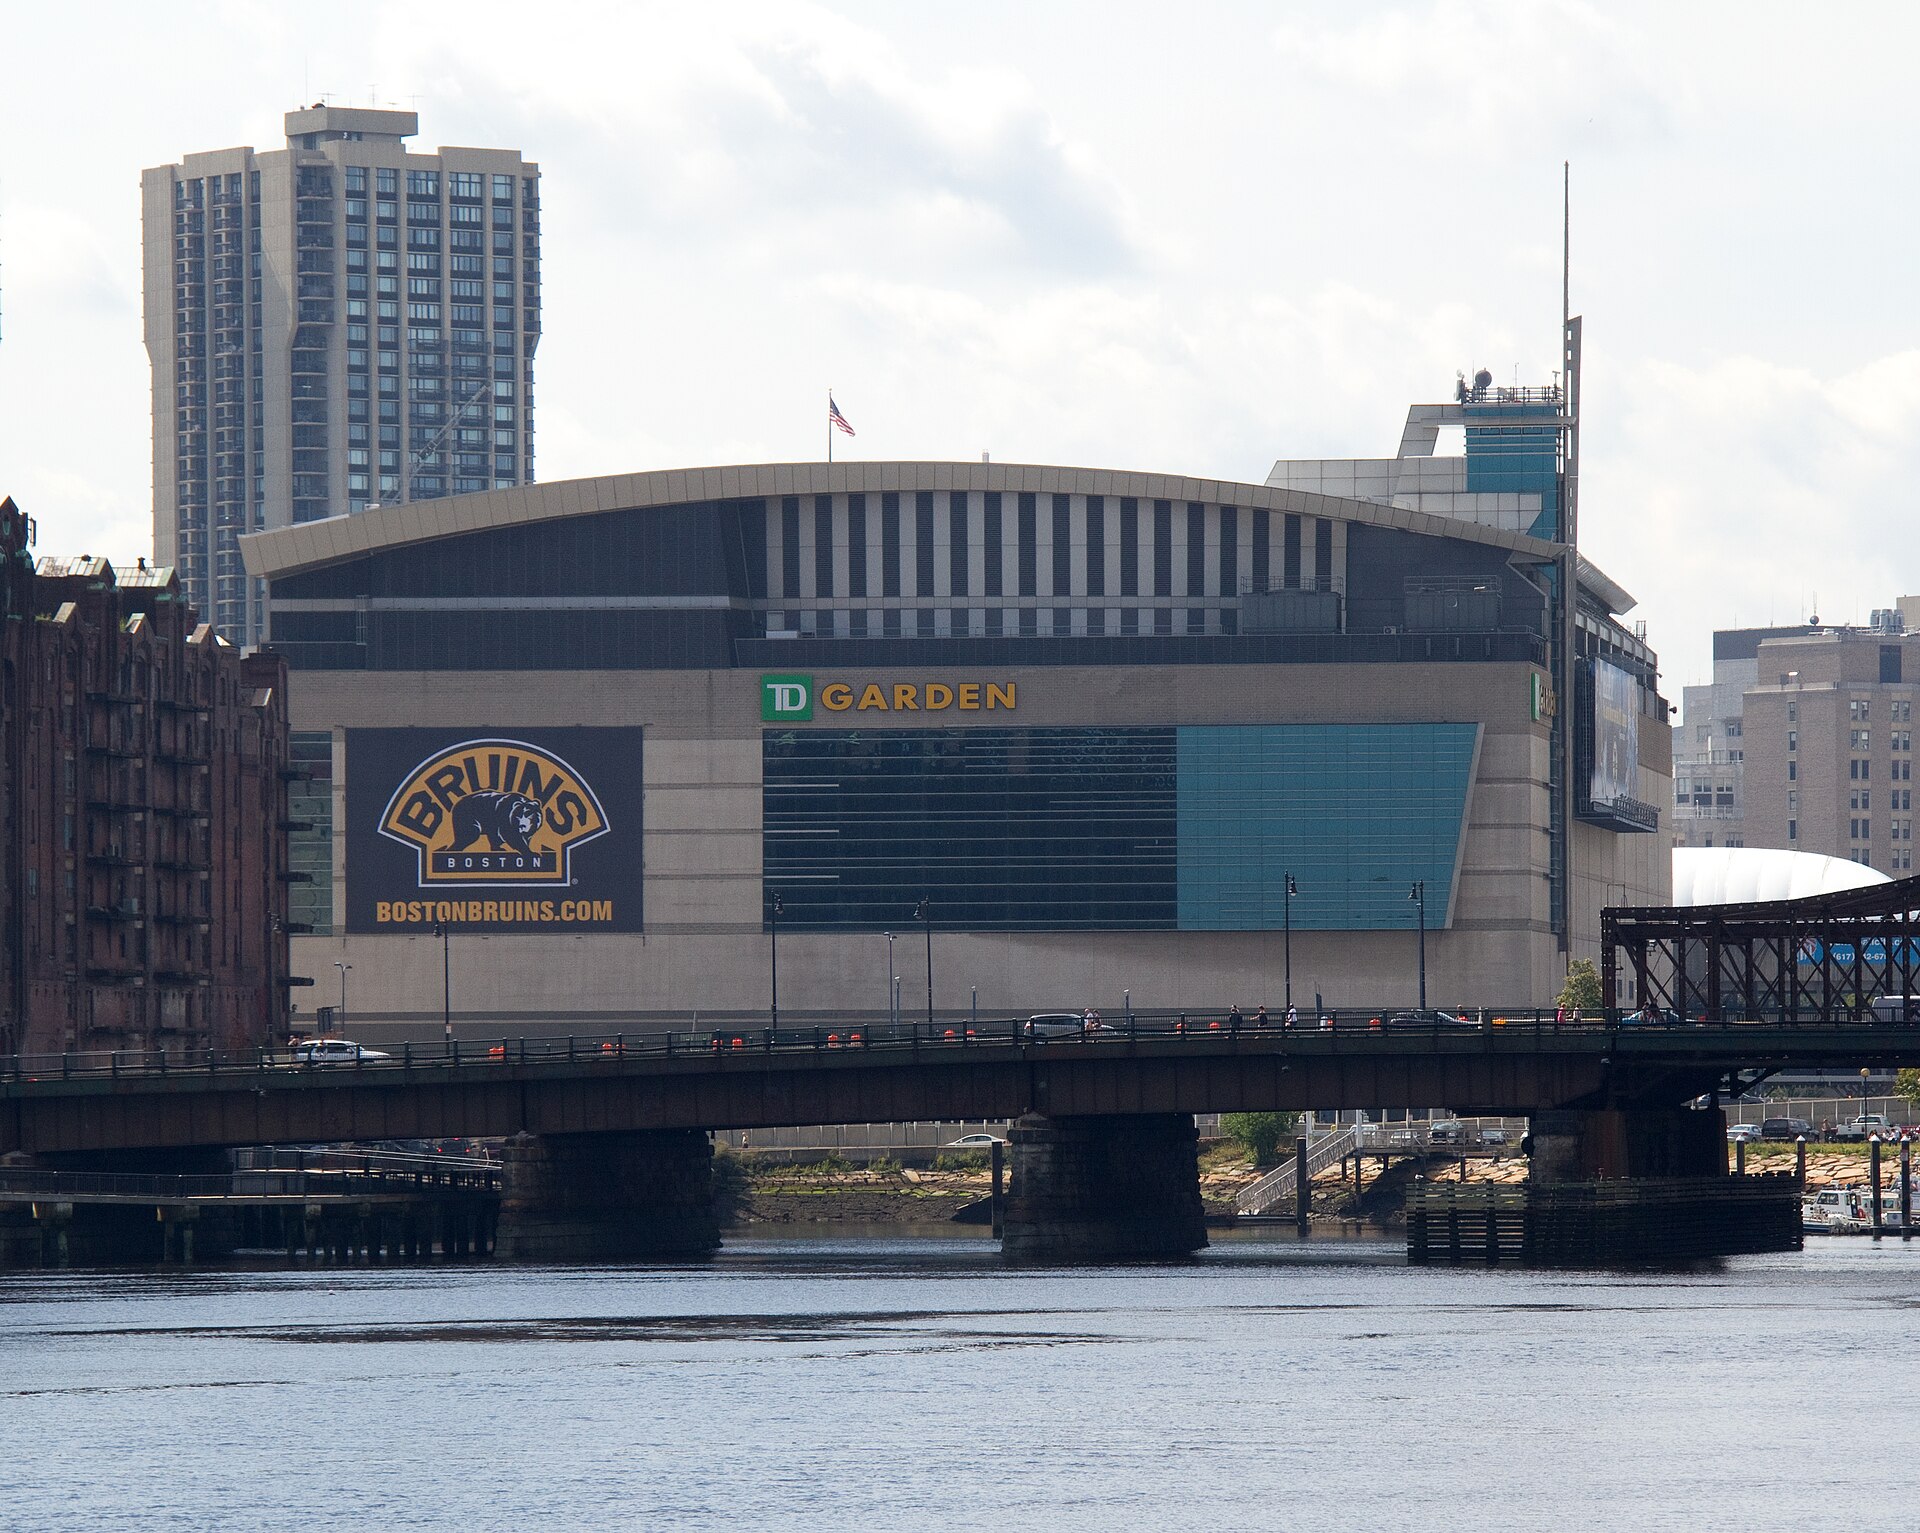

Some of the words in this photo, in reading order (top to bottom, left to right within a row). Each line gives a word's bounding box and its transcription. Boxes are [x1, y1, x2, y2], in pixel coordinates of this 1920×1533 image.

[766, 683, 807, 711] TD
[821, 682, 1016, 711] GARDEN
[395, 753, 588, 839] BRUINS
[447, 857, 542, 868] BOSTON
[376, 900, 612, 922] BOSTONBRUINS.COM
[1832, 952, 1856, 961] (617)
